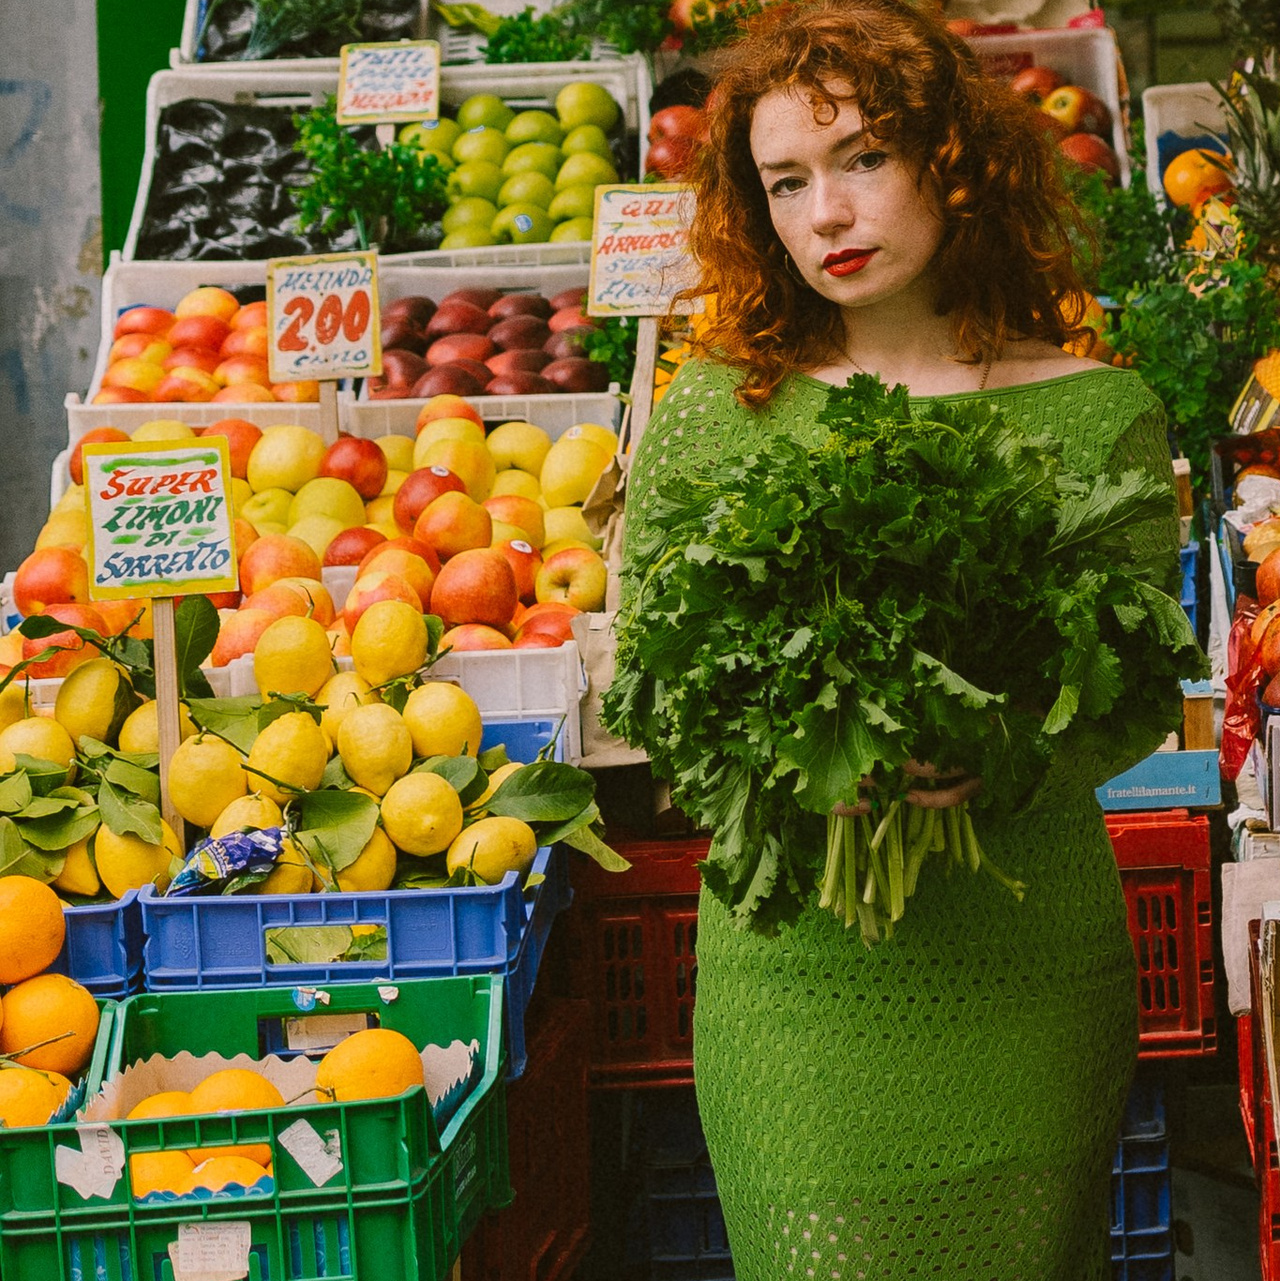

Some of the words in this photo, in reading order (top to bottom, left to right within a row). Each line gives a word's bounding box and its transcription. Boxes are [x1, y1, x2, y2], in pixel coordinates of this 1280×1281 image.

[100, 468, 219, 501] SUPER
[101, 494, 225, 533] LIMONI
[143, 529, 183, 548] DI
[95, 536, 231, 584] SORRENTO
[1107, 785, 1197, 800] fratellilamante.it
